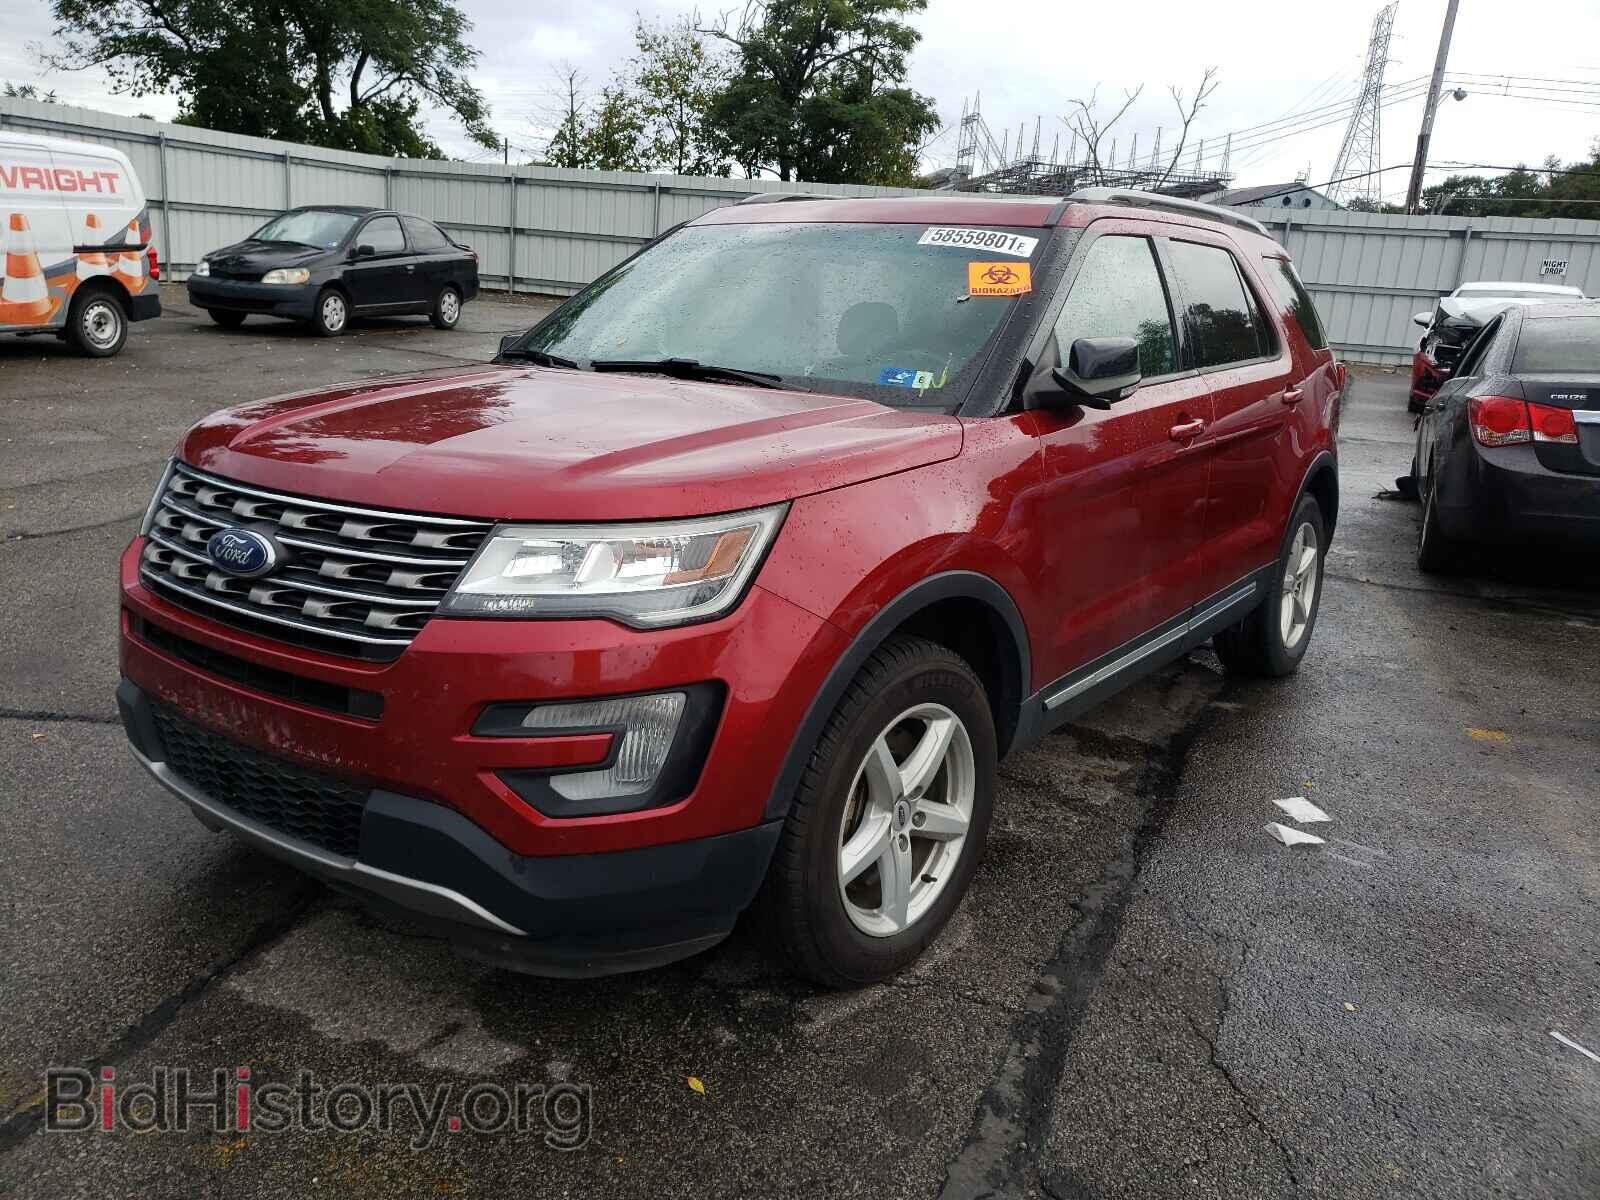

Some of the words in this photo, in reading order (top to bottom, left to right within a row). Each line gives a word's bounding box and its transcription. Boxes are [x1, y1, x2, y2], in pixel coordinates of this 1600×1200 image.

[1543, 260, 1568, 268] NIGHT
[1544, 267, 1563, 275] DROP
[215, 534, 255, 565] Ford
